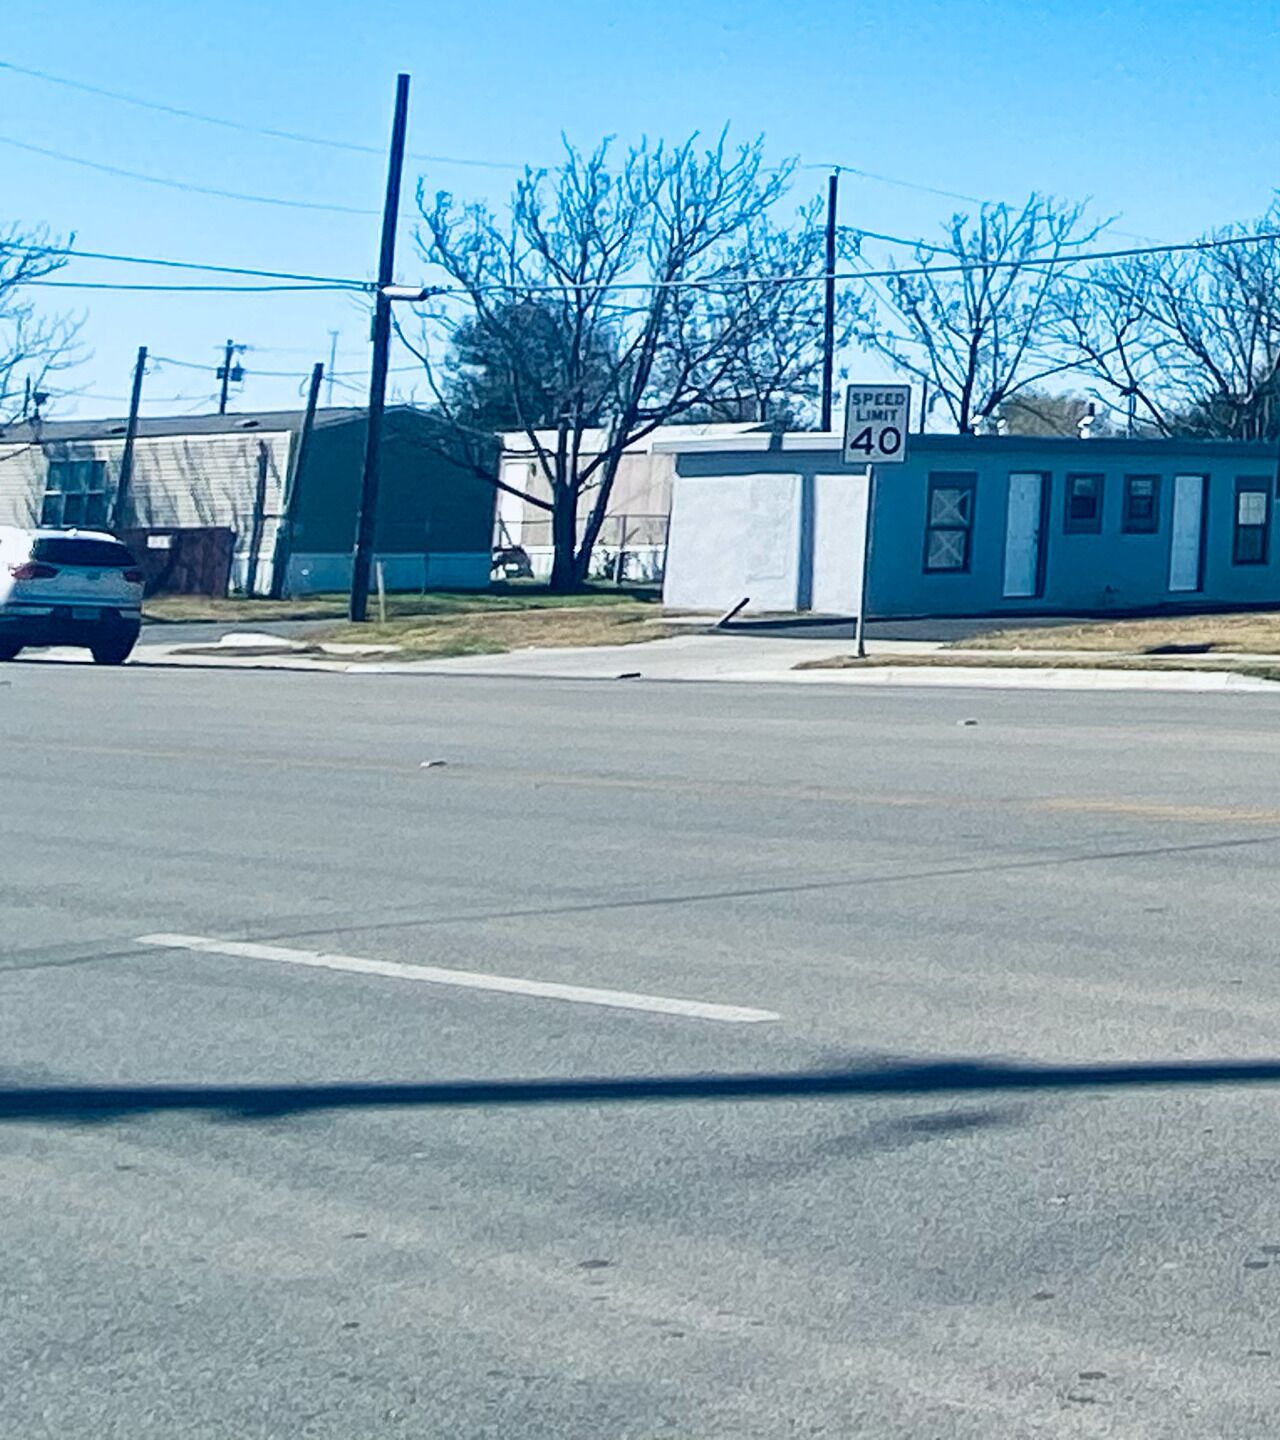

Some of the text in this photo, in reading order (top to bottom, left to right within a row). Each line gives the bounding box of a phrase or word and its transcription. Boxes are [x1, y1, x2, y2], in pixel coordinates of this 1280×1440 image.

[851, 392, 906, 406] SPEED
[855, 408, 898, 422] LIMIT
[849, 426, 902, 456] 40
